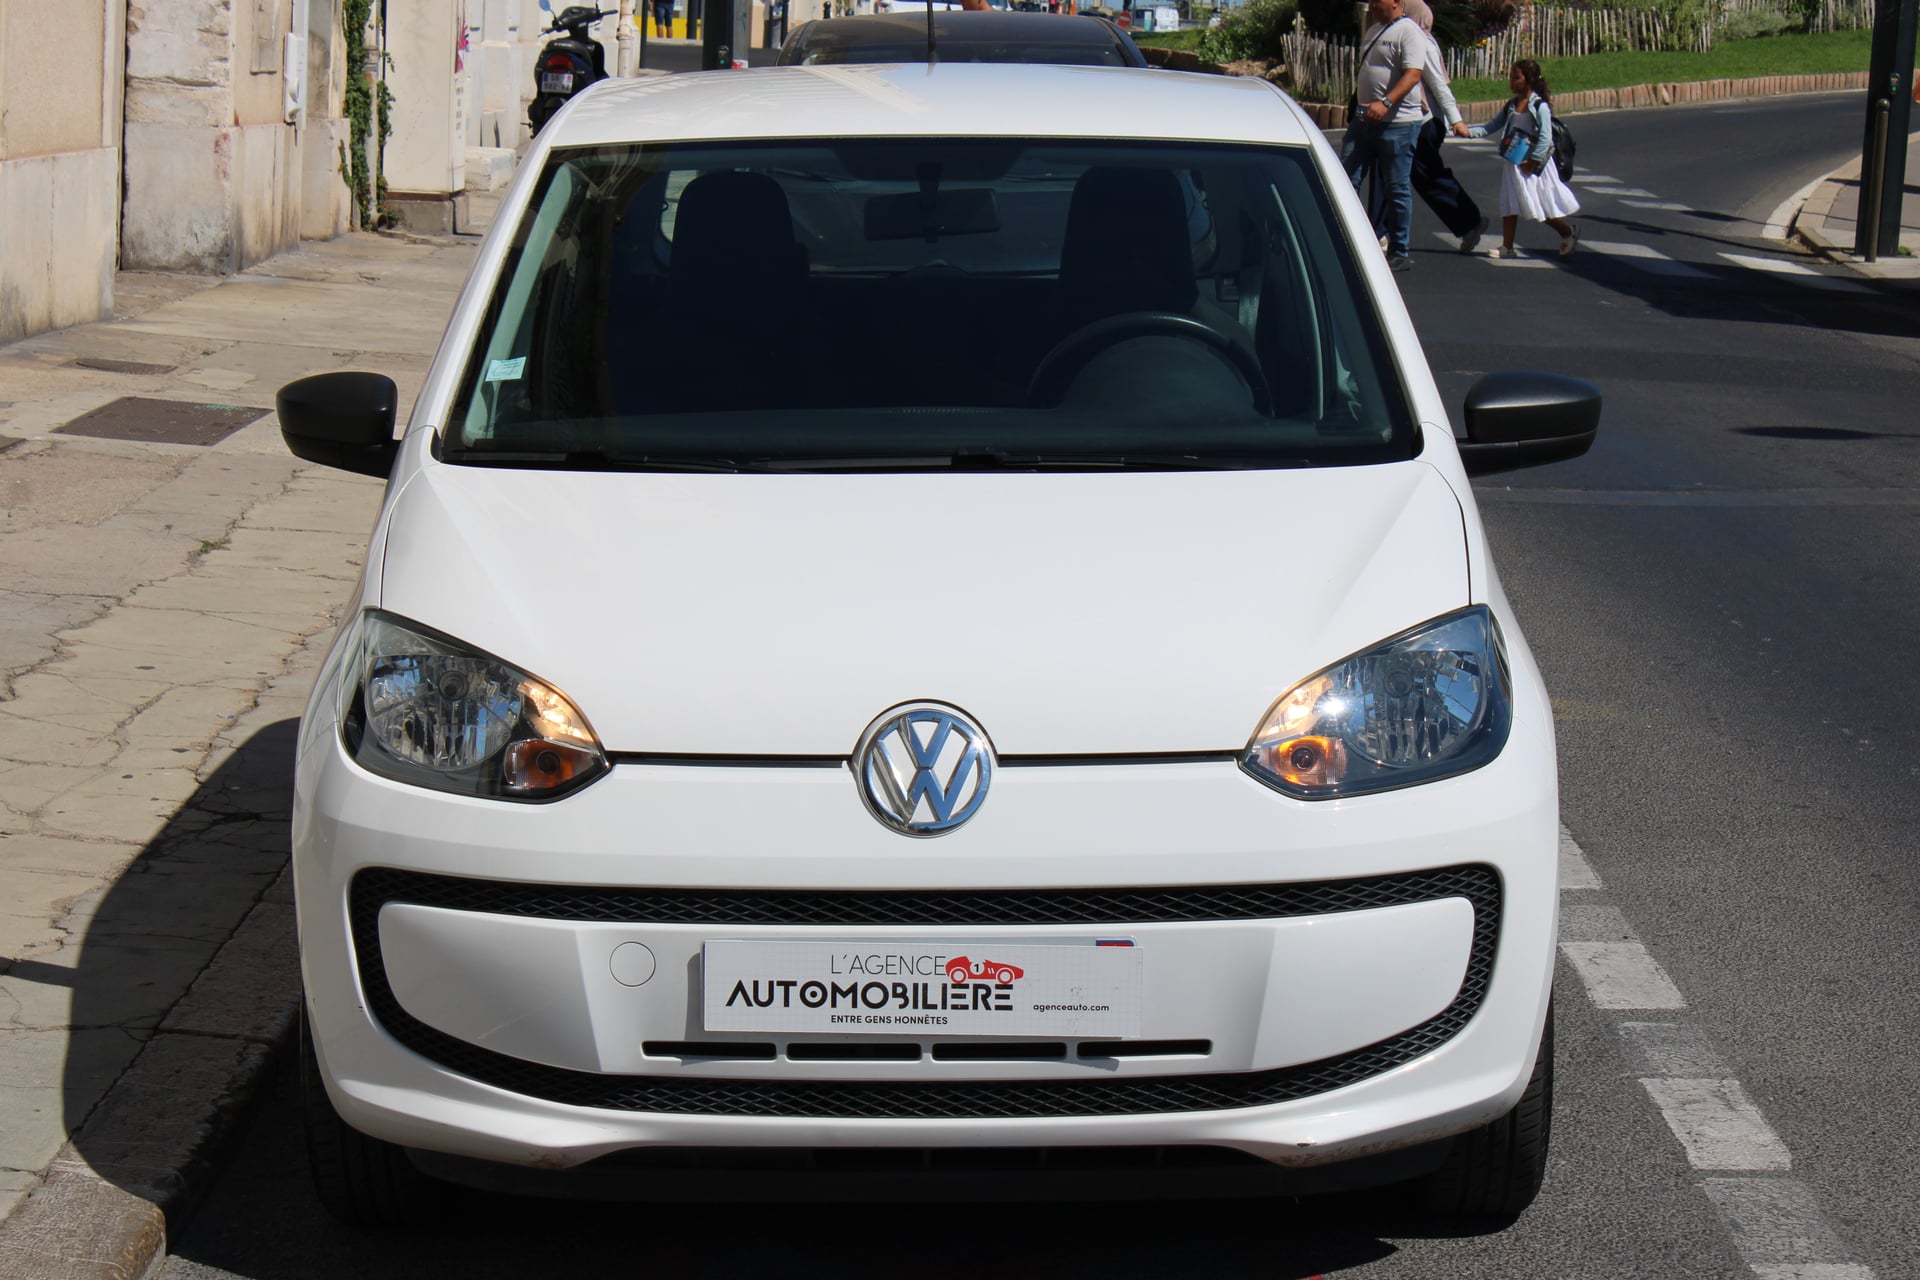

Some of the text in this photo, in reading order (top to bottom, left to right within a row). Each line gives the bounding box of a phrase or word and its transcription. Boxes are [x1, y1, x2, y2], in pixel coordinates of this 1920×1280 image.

[831, 954, 946, 976] L'AGENCE
[974, 963, 980, 973] 1
[725, 979, 1014, 1011] AUTOMOBILIERE
[1033, 1003, 1110, 1013] agenceauto.com
[831, 1014, 948, 1025] ENTRE GENS HONNÊTES
